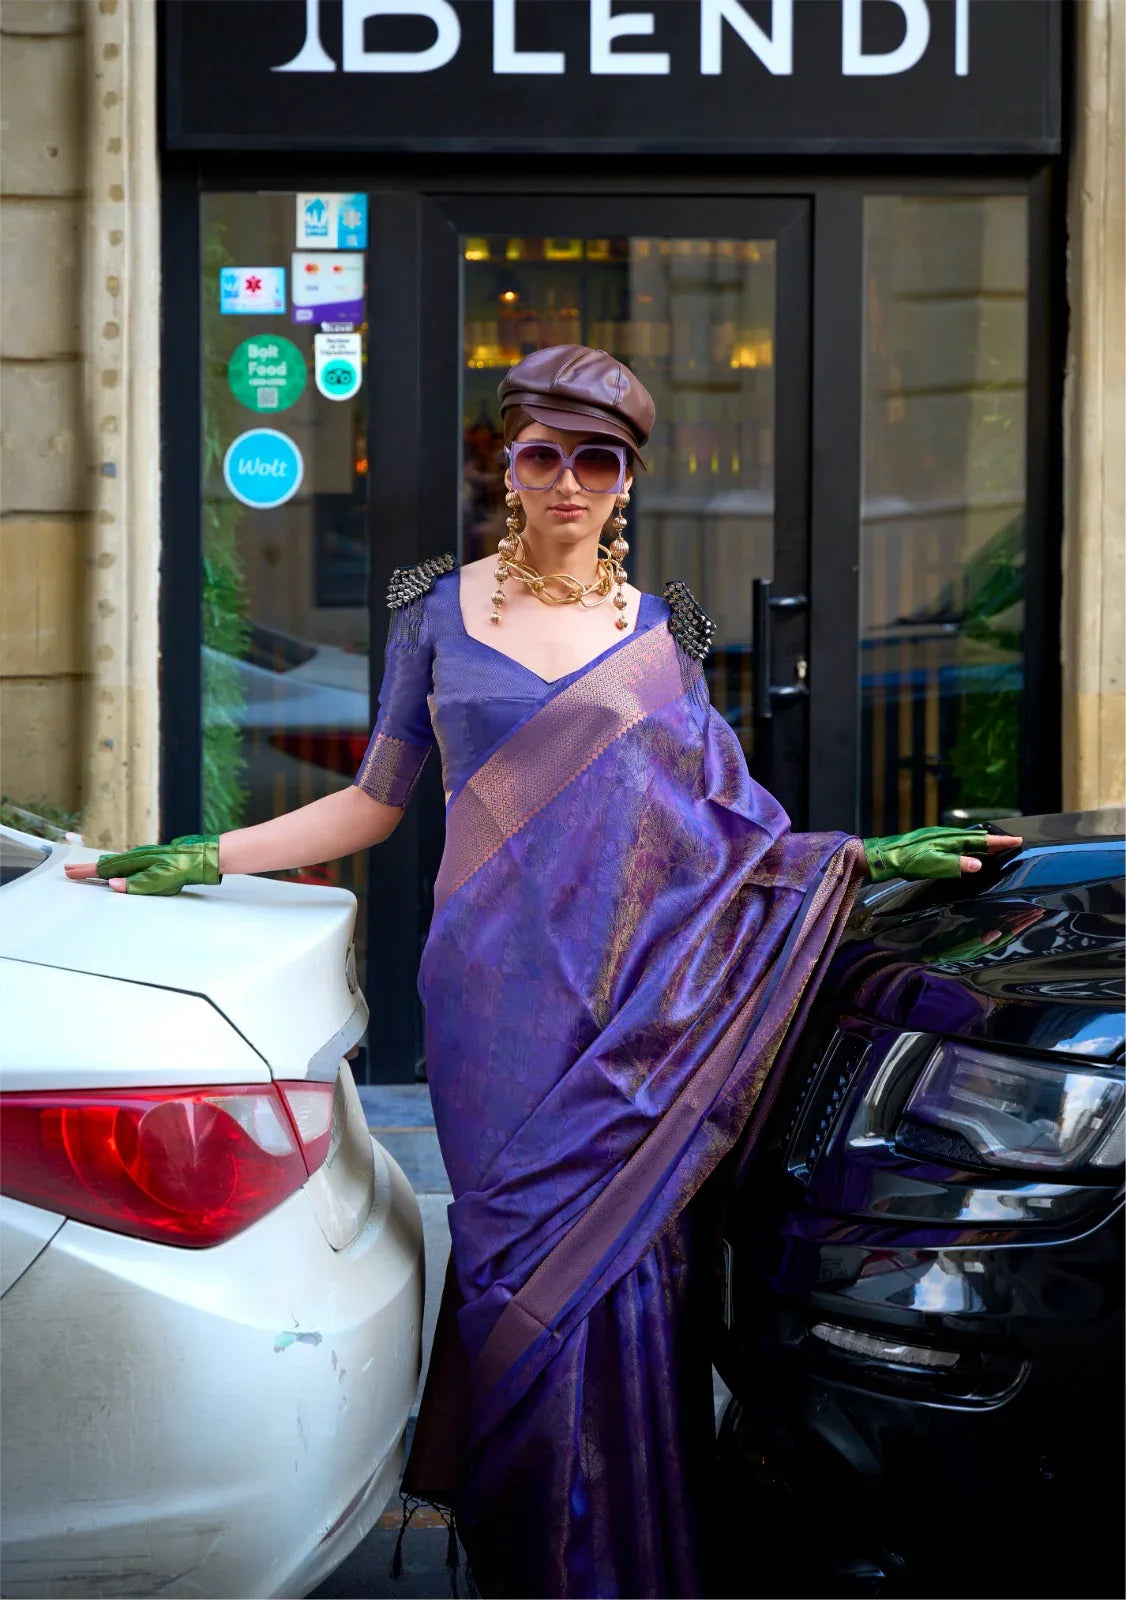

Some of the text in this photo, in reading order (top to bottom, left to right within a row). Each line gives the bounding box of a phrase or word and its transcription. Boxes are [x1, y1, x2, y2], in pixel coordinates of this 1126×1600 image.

[248, 344, 279, 361] Bolt
[248, 361, 287, 377] Food
[238, 458, 287, 477] Wolt
